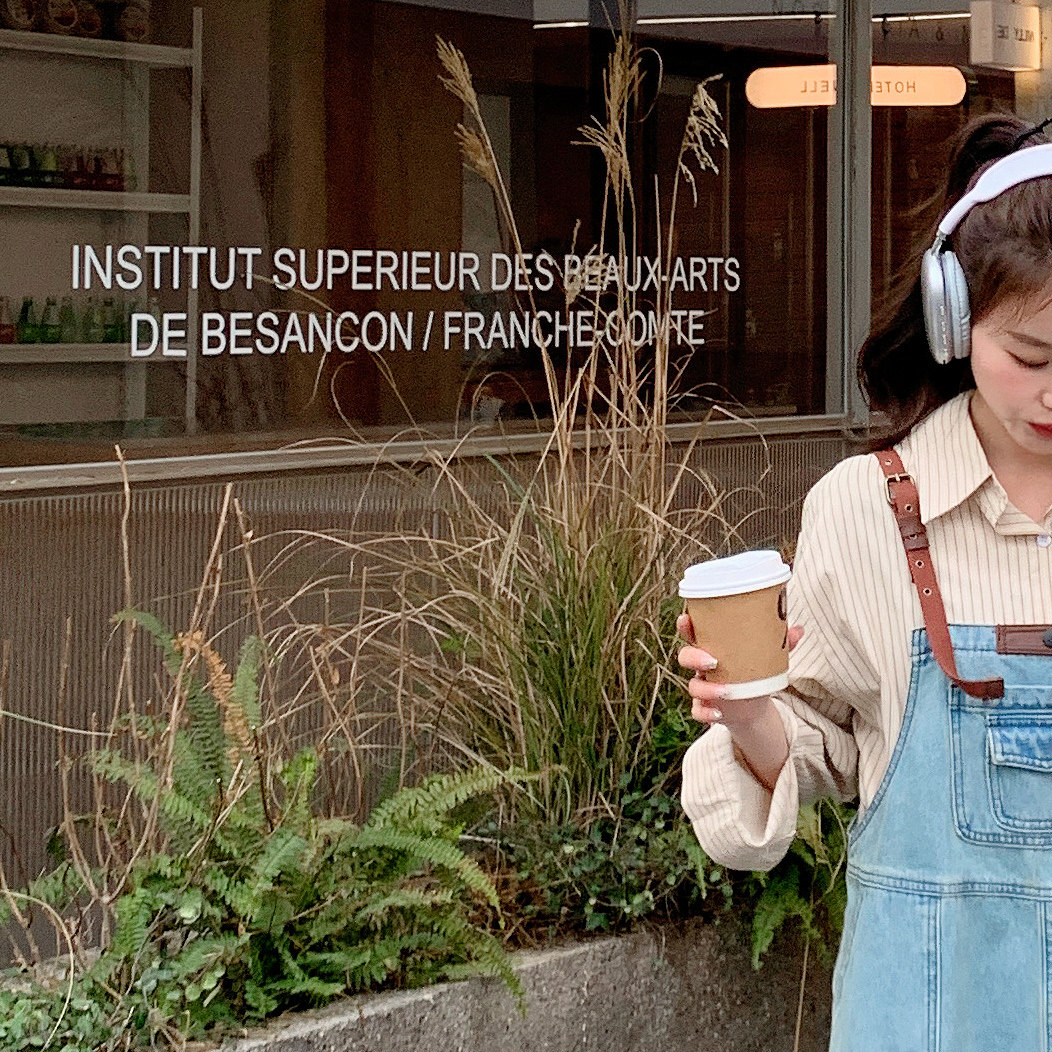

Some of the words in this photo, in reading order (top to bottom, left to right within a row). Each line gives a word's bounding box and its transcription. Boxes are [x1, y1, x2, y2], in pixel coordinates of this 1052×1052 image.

[72, 244, 262, 290] INSTITUT
[272, 247, 481, 292] SUPERIEUR
[491, 252, 554, 292] DES
[564, 254, 740, 292] BEAUX-ARTS
[131, 312, 187, 357] DE
[202, 310, 413, 356] BESANCON
[444, 309, 705, 351] FRANCHE-COMTE
